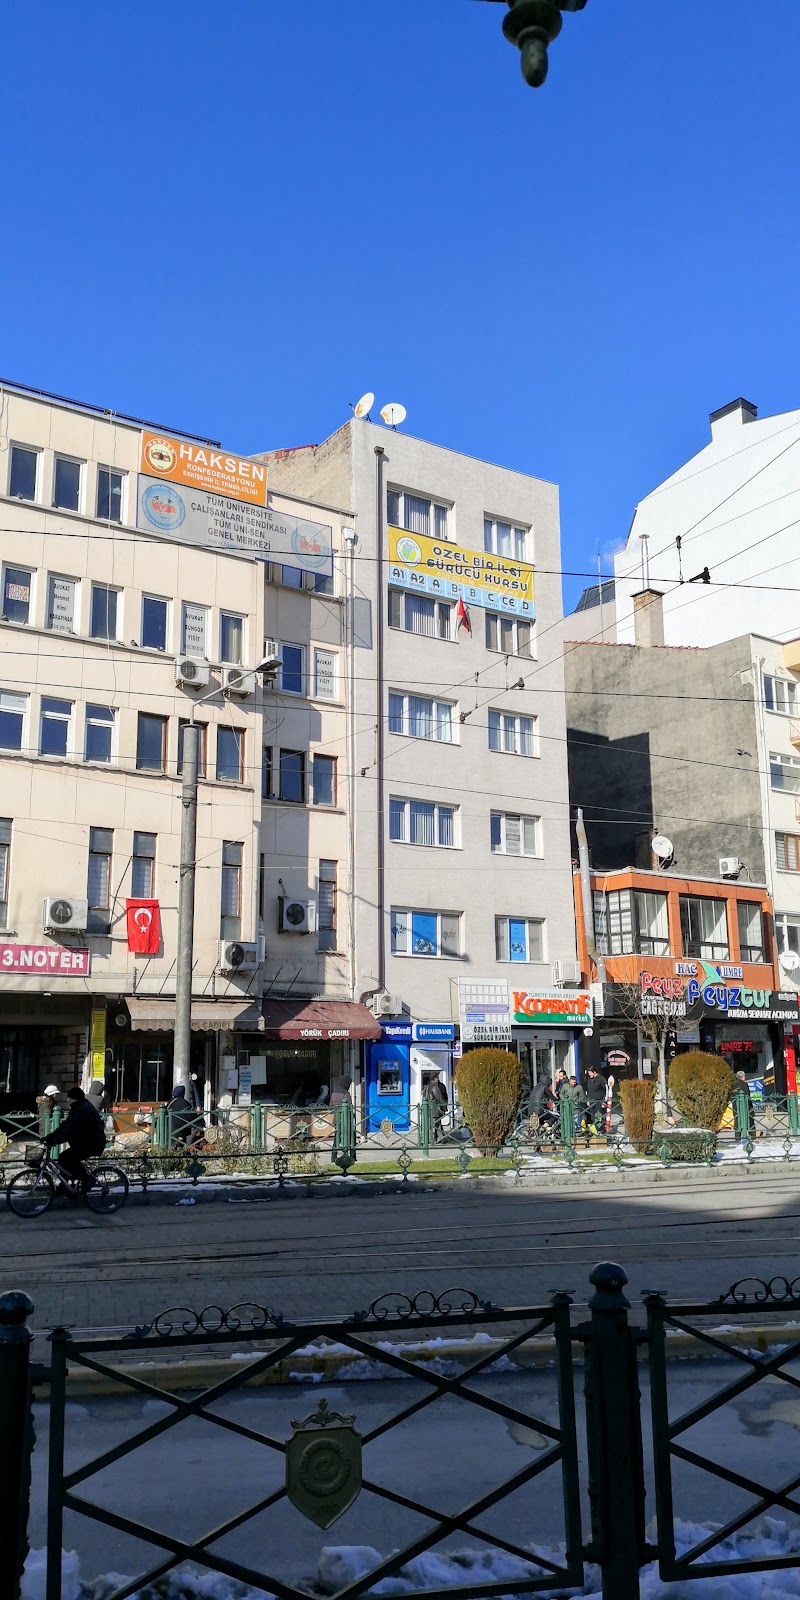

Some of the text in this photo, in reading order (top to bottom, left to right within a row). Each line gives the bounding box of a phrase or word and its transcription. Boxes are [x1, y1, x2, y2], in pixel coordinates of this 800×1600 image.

[180, 444, 265, 482] HAKSEN
[186, 463, 256, 488] KONFEDERASYONU
[182, 470, 214, 484] ESKİŞEHİR
[221, 480, 258, 496] TEMSİLCİLİĞİ
[200, 482, 240, 496] www.haksen.org.tr
[206, 496, 273, 521] TÜM ÜNİVERSİTE
[190, 502, 244, 523] ÇALIŞANLARI
[245, 516, 287, 535] SENDİKASI
[213, 518, 266, 539] TÜM ÜNİ-SEN
[207, 527, 234, 541] GENEL
[236, 535, 271, 550] MERKEZİ
[432, 545, 522, 578] ÖZEL BİR İLGİ
[392, 568, 405, 579] A1
[410, 573, 425, 584] A2
[426, 558, 481, 580] SÜRÜCÜ
[484, 573, 528, 591] KURSU
[432, 579, 440, 588] A
[469, 588, 476, 597] B
[487, 593, 494, 602] C
[502, 597, 515, 607] CE
[522, 601, 529, 610] D
[185, 613, 203, 621] AVUKAT
[2, 949, 84, 969] 3.NOTER
[677, 963, 743, 978] HAC UMRE
[528, 991, 548, 999] TÜRKİYE
[566, 1014, 588, 1022] market
[202, 1021, 231, 1030] ÇADIRI
[385, 1026, 411, 1036] YapıKredi
[473, 1025, 510, 1033] ÖZEL BİR İLGİ
[300, 1028, 350, 1038] YÖRÜK ÇADIRI
[473, 1033, 511, 1041] SÜRÜCÜ KURSU
